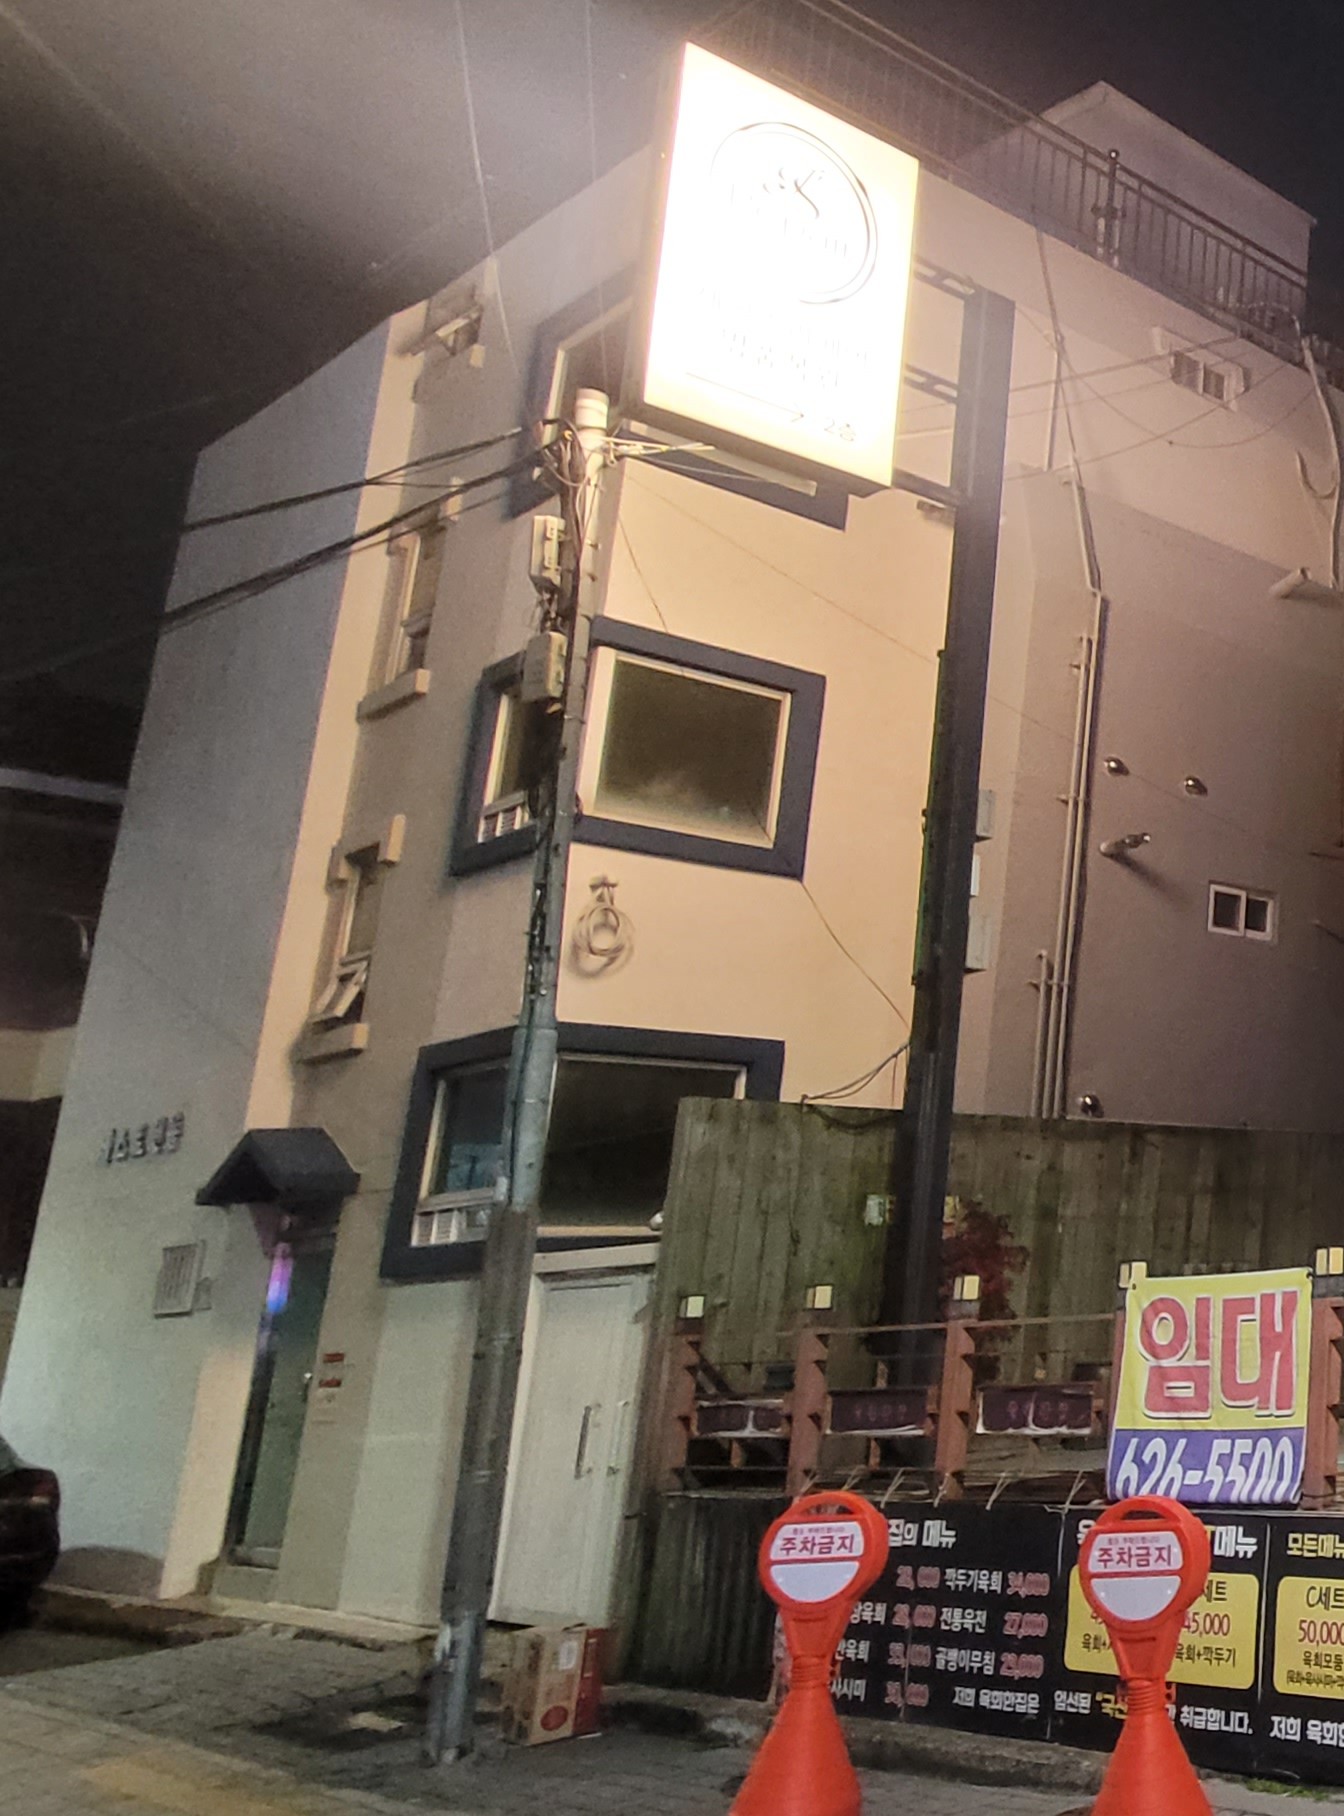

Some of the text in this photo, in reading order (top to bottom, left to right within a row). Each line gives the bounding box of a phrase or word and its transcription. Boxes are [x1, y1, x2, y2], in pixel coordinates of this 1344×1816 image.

[1139, 1289, 1299, 1418] 임대
[780, 1533, 854, 1556] 주차금지
[923, 1520, 957, 1548] 메뉴
[1097, 1544, 1172, 1569] 주차금지
[1180, 1704, 1253, 1735] 취급합니다.
[1269, 1715, 1301, 1741] 저희
